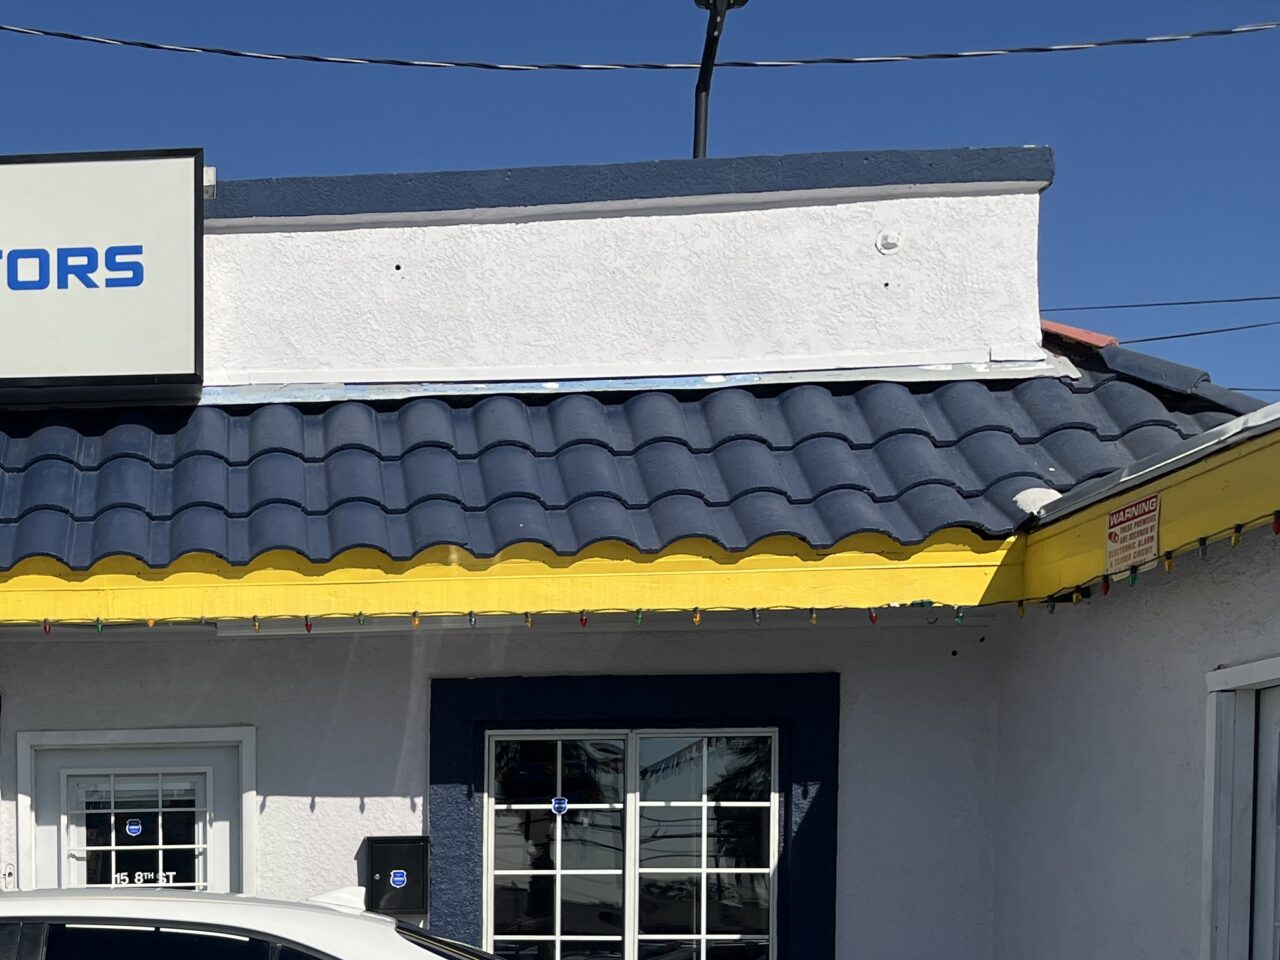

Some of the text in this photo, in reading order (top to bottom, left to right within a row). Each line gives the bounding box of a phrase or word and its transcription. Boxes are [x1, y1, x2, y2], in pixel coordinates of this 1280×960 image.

[1109, 499, 1157, 527] WARNING
[115, 872, 176, 885] 15 8TH ST
